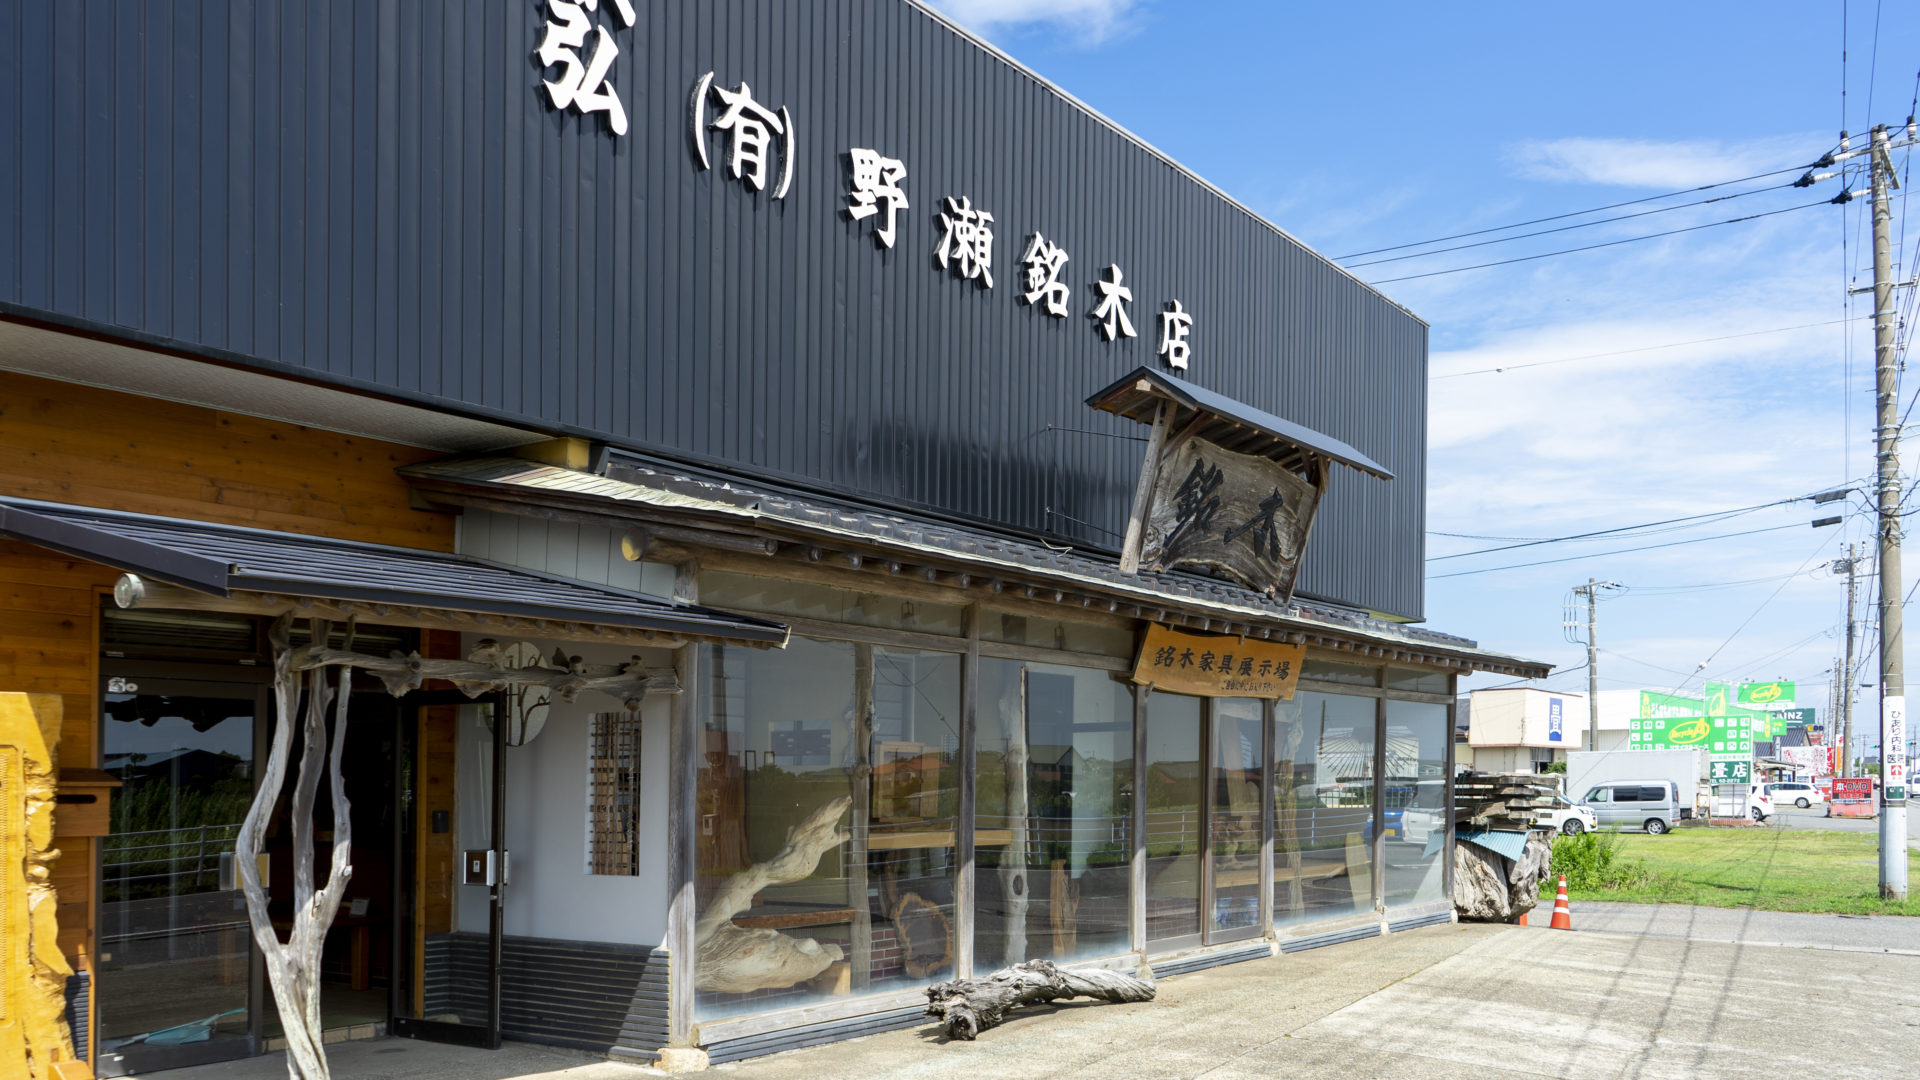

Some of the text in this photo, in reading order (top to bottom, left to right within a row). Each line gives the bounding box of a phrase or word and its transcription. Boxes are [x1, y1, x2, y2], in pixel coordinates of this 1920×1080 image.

[533, 0, 637, 136] 弘
[1154, 645, 1291, 681] 銘木家具展示場
